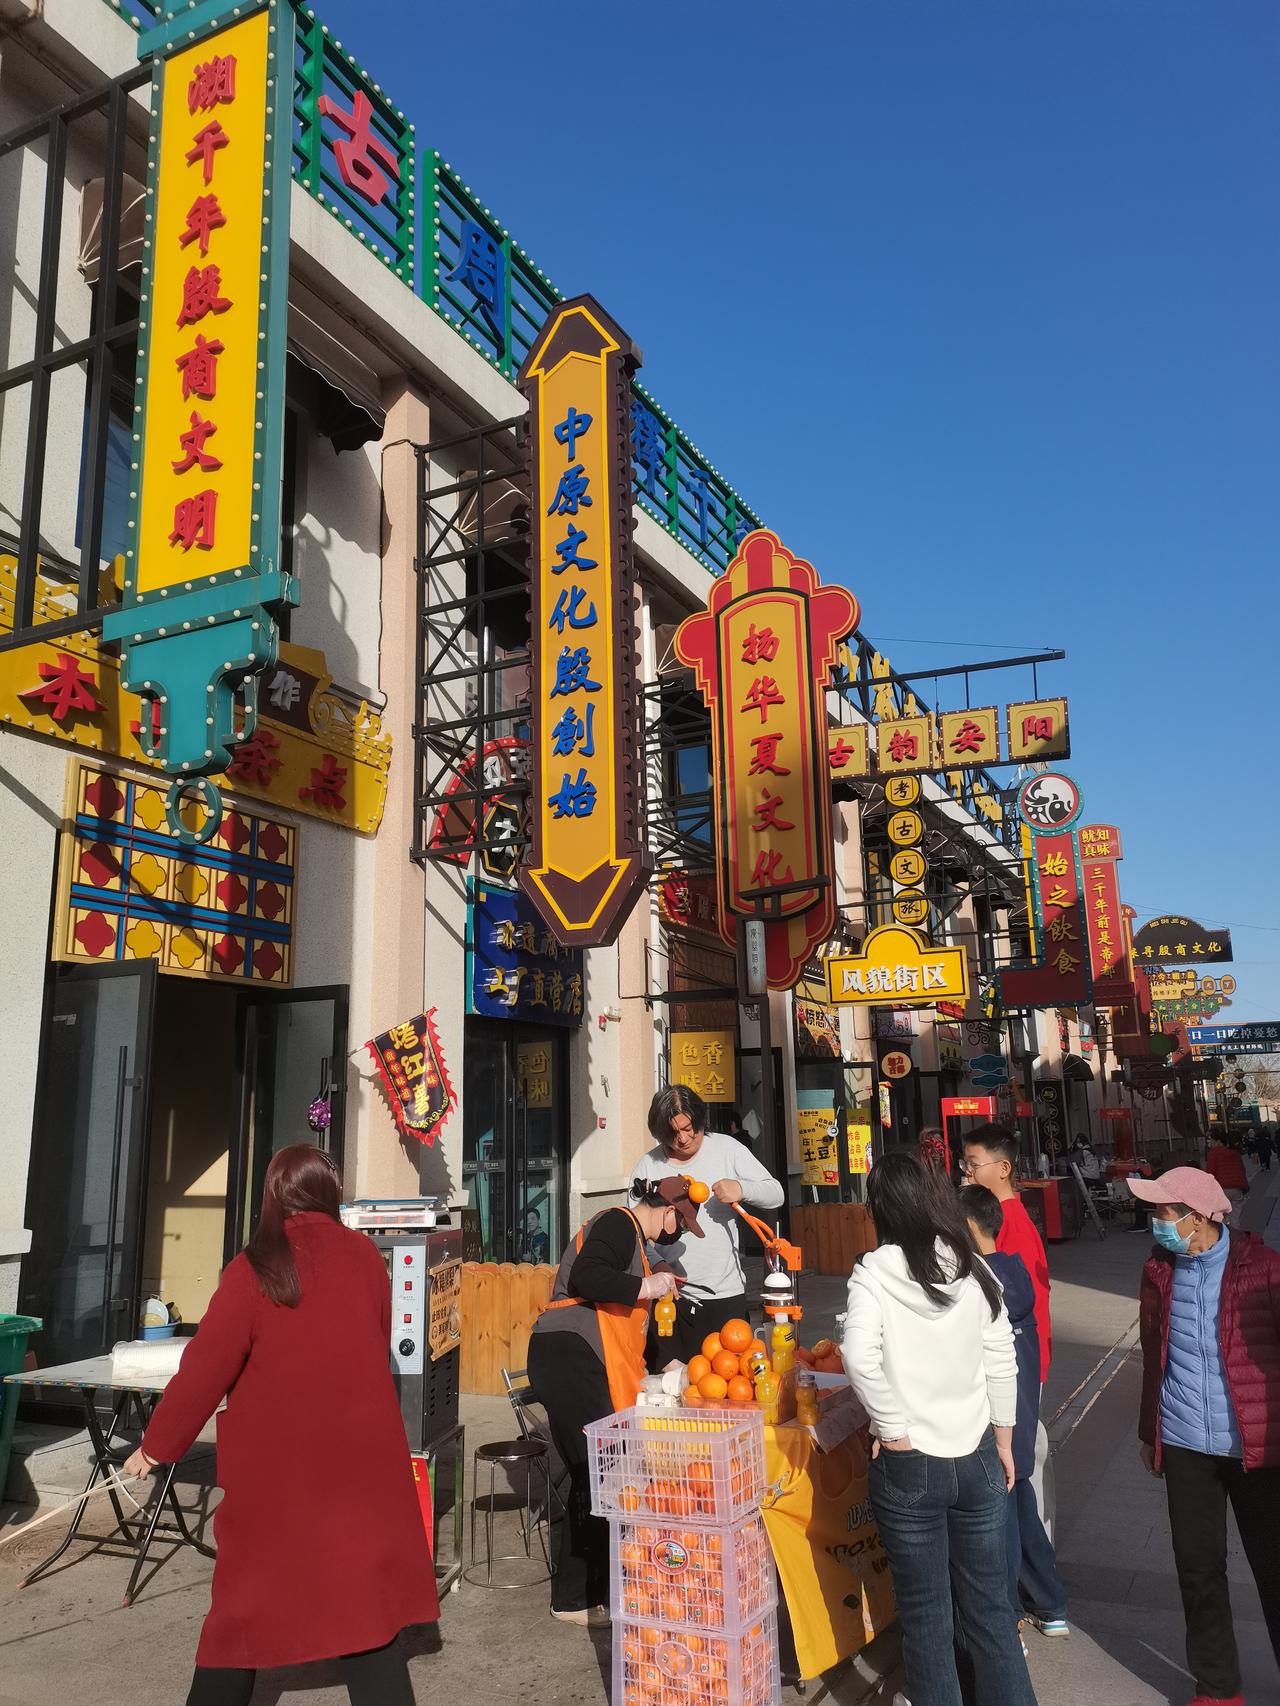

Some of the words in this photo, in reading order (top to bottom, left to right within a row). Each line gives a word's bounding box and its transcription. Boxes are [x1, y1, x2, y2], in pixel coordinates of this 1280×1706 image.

[168, 54, 237, 553] 溯千年殷商文明
[547, 407, 602, 819] 中原文化殷創始
[740, 623, 796, 888] 扬华夏文化
[828, 714, 1054, 768] 古韵安阳
[1091, 868, 1115, 978] 三千年前是帝都
[841, 962, 950, 995] 风貌街区
[388, 1021, 430, 1116] 烤红薯
[679, 1041, 724, 1066] 色香
